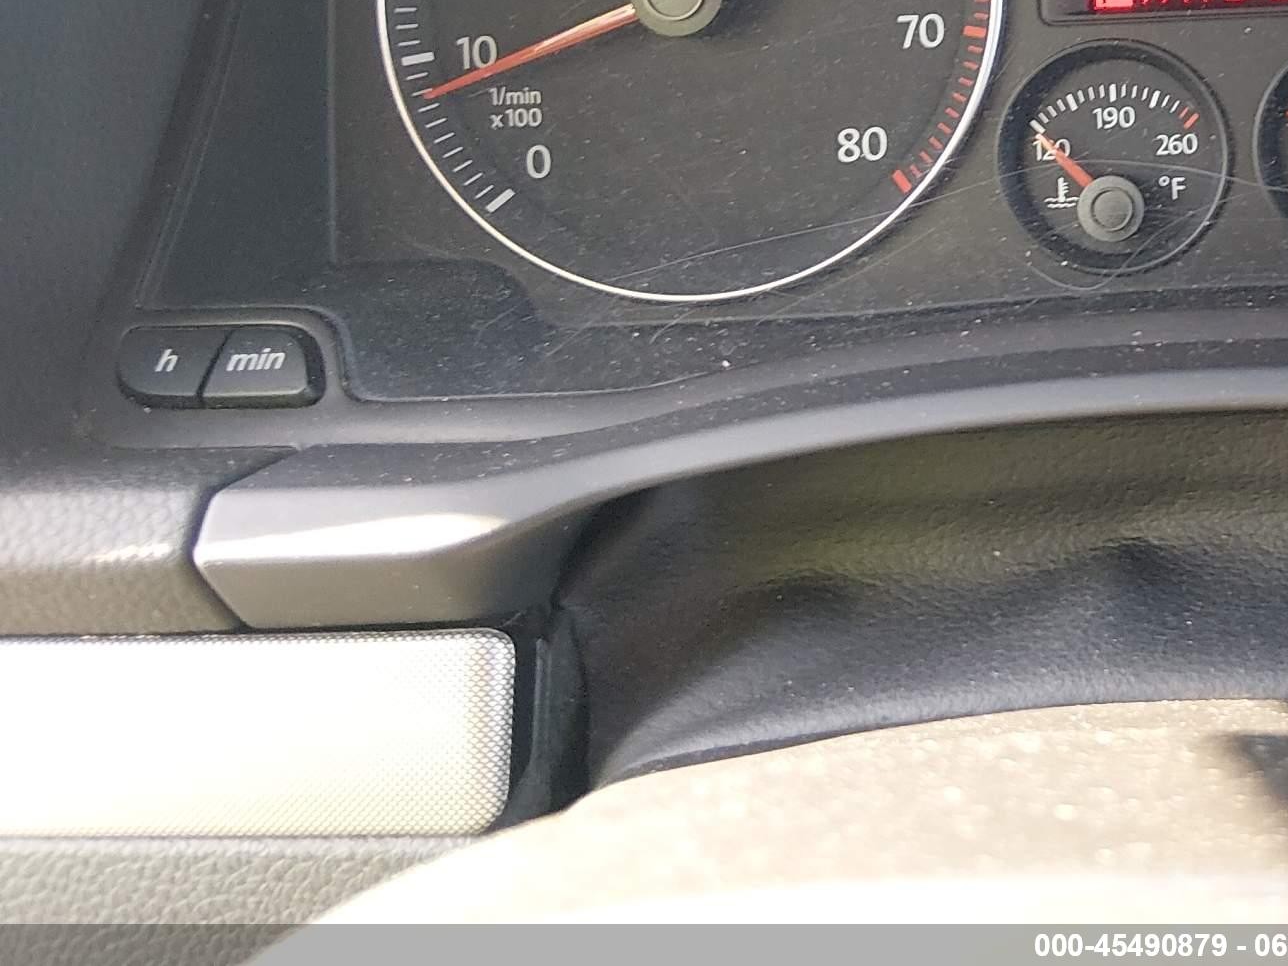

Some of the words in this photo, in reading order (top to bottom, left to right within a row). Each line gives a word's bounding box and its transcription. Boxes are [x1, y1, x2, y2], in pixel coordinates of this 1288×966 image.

[897, 13, 945, 49] 70
[456, 35, 498, 70] 10
[488, 87, 542, 105] 1/min
[1092, 106, 1136, 130] 190
[837, 126, 888, 163] 80
[1156, 134, 1198, 155] 260
[526, 145, 551, 178] 0
[1159, 176, 1187, 200] °F
[155, 348, 178, 372] h
[226, 347, 286, 371] min
